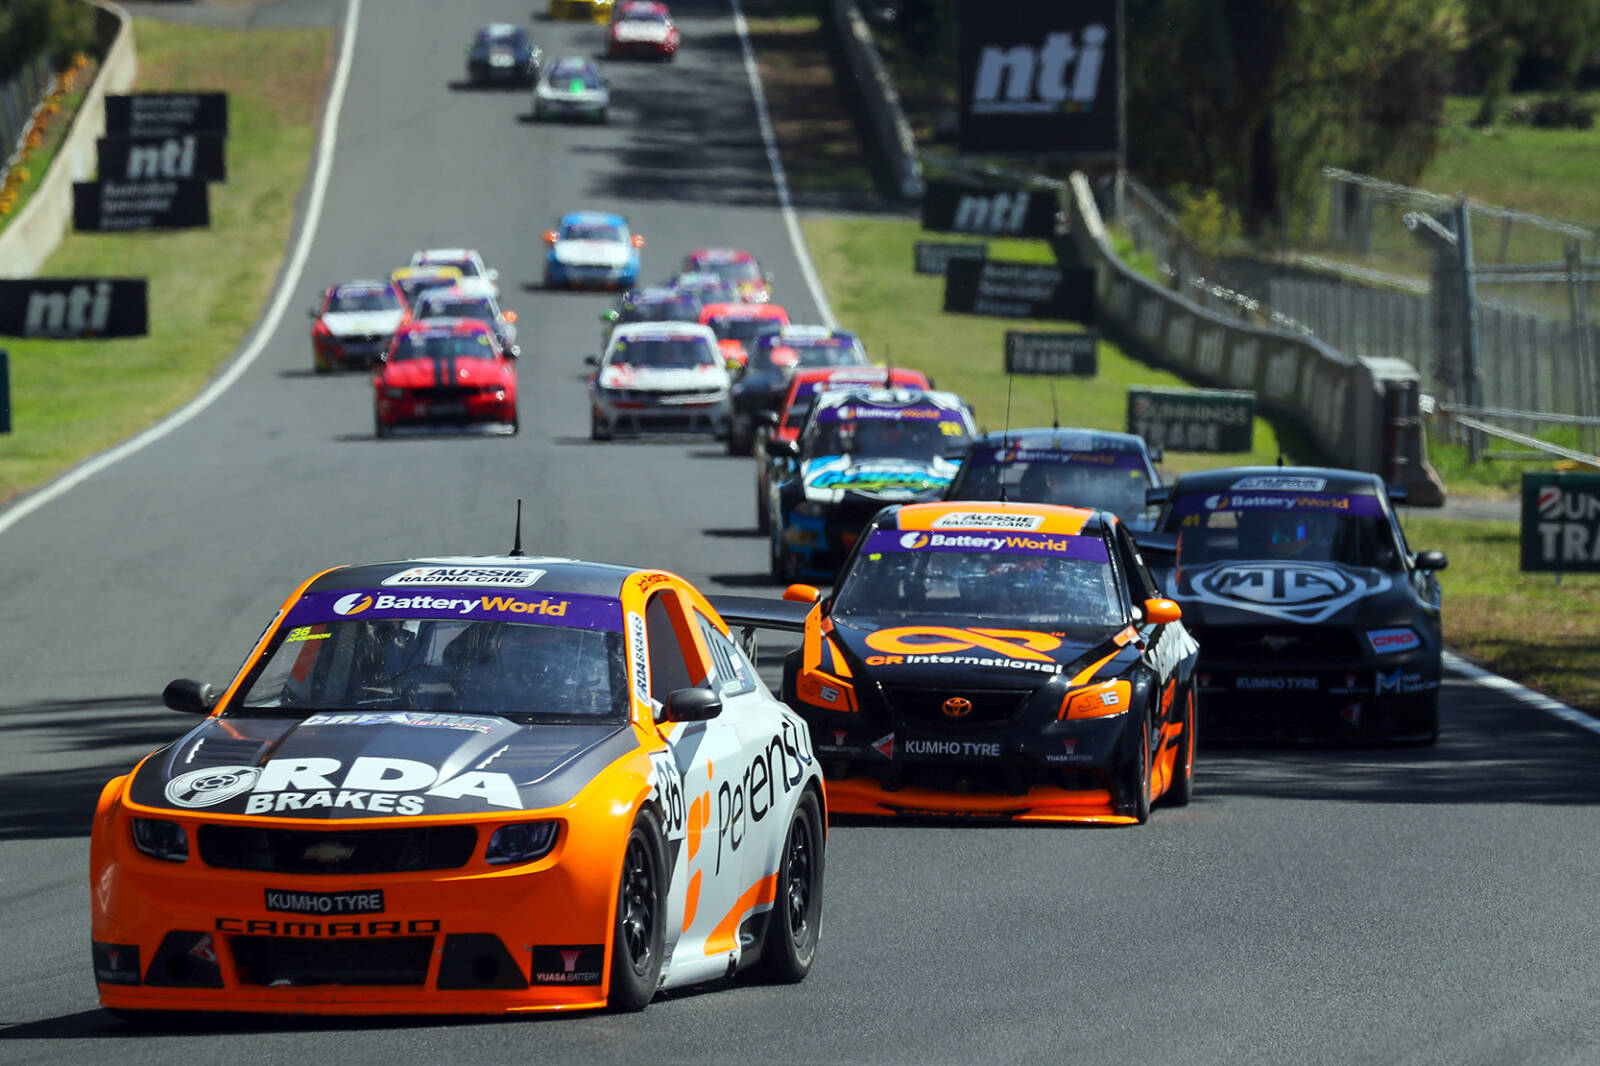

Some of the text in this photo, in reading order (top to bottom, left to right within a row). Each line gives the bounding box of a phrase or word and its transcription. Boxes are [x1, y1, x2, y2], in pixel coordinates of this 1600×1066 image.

[975, 23, 1107, 101] nti
[127, 136, 196, 178] nti
[25, 281, 113, 331] nti
[962, 514, 1034, 523] AUSSIE
[397, 576, 527, 585] RACING CARS
[429, 568, 537, 579] AUSSIE
[291, 626, 312, 638] 36
[865, 655, 1064, 674] CR International
[905, 740, 1001, 757] KUMHO TYRE
[251, 756, 524, 810] RDA
[245, 791, 426, 817] BRAKES
[655, 762, 684, 834] 36
[266, 892, 382, 911] KUMHO TYRE
[215, 918, 441, 936] CAMARO
[536, 972, 566, 981] YUASA
